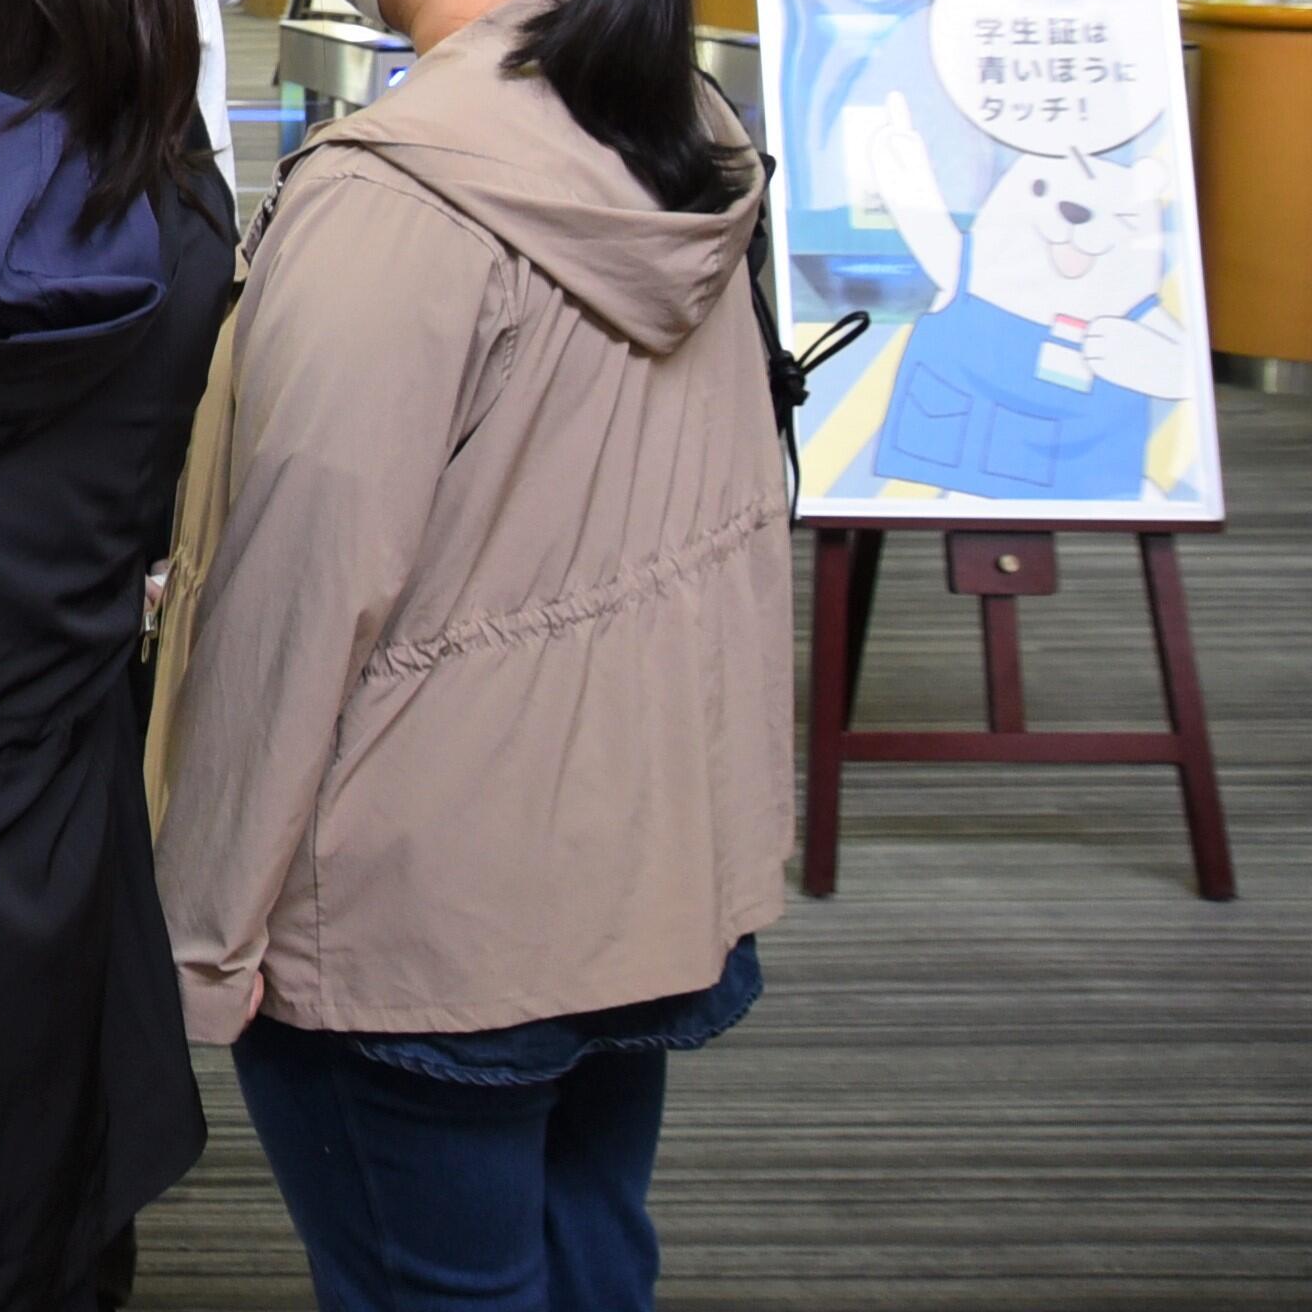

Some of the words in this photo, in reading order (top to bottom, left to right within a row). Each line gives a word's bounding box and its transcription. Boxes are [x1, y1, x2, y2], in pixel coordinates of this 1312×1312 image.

[976, 16, 1109, 47] 学生証は
[977, 54, 1137, 85] 青いほうに
